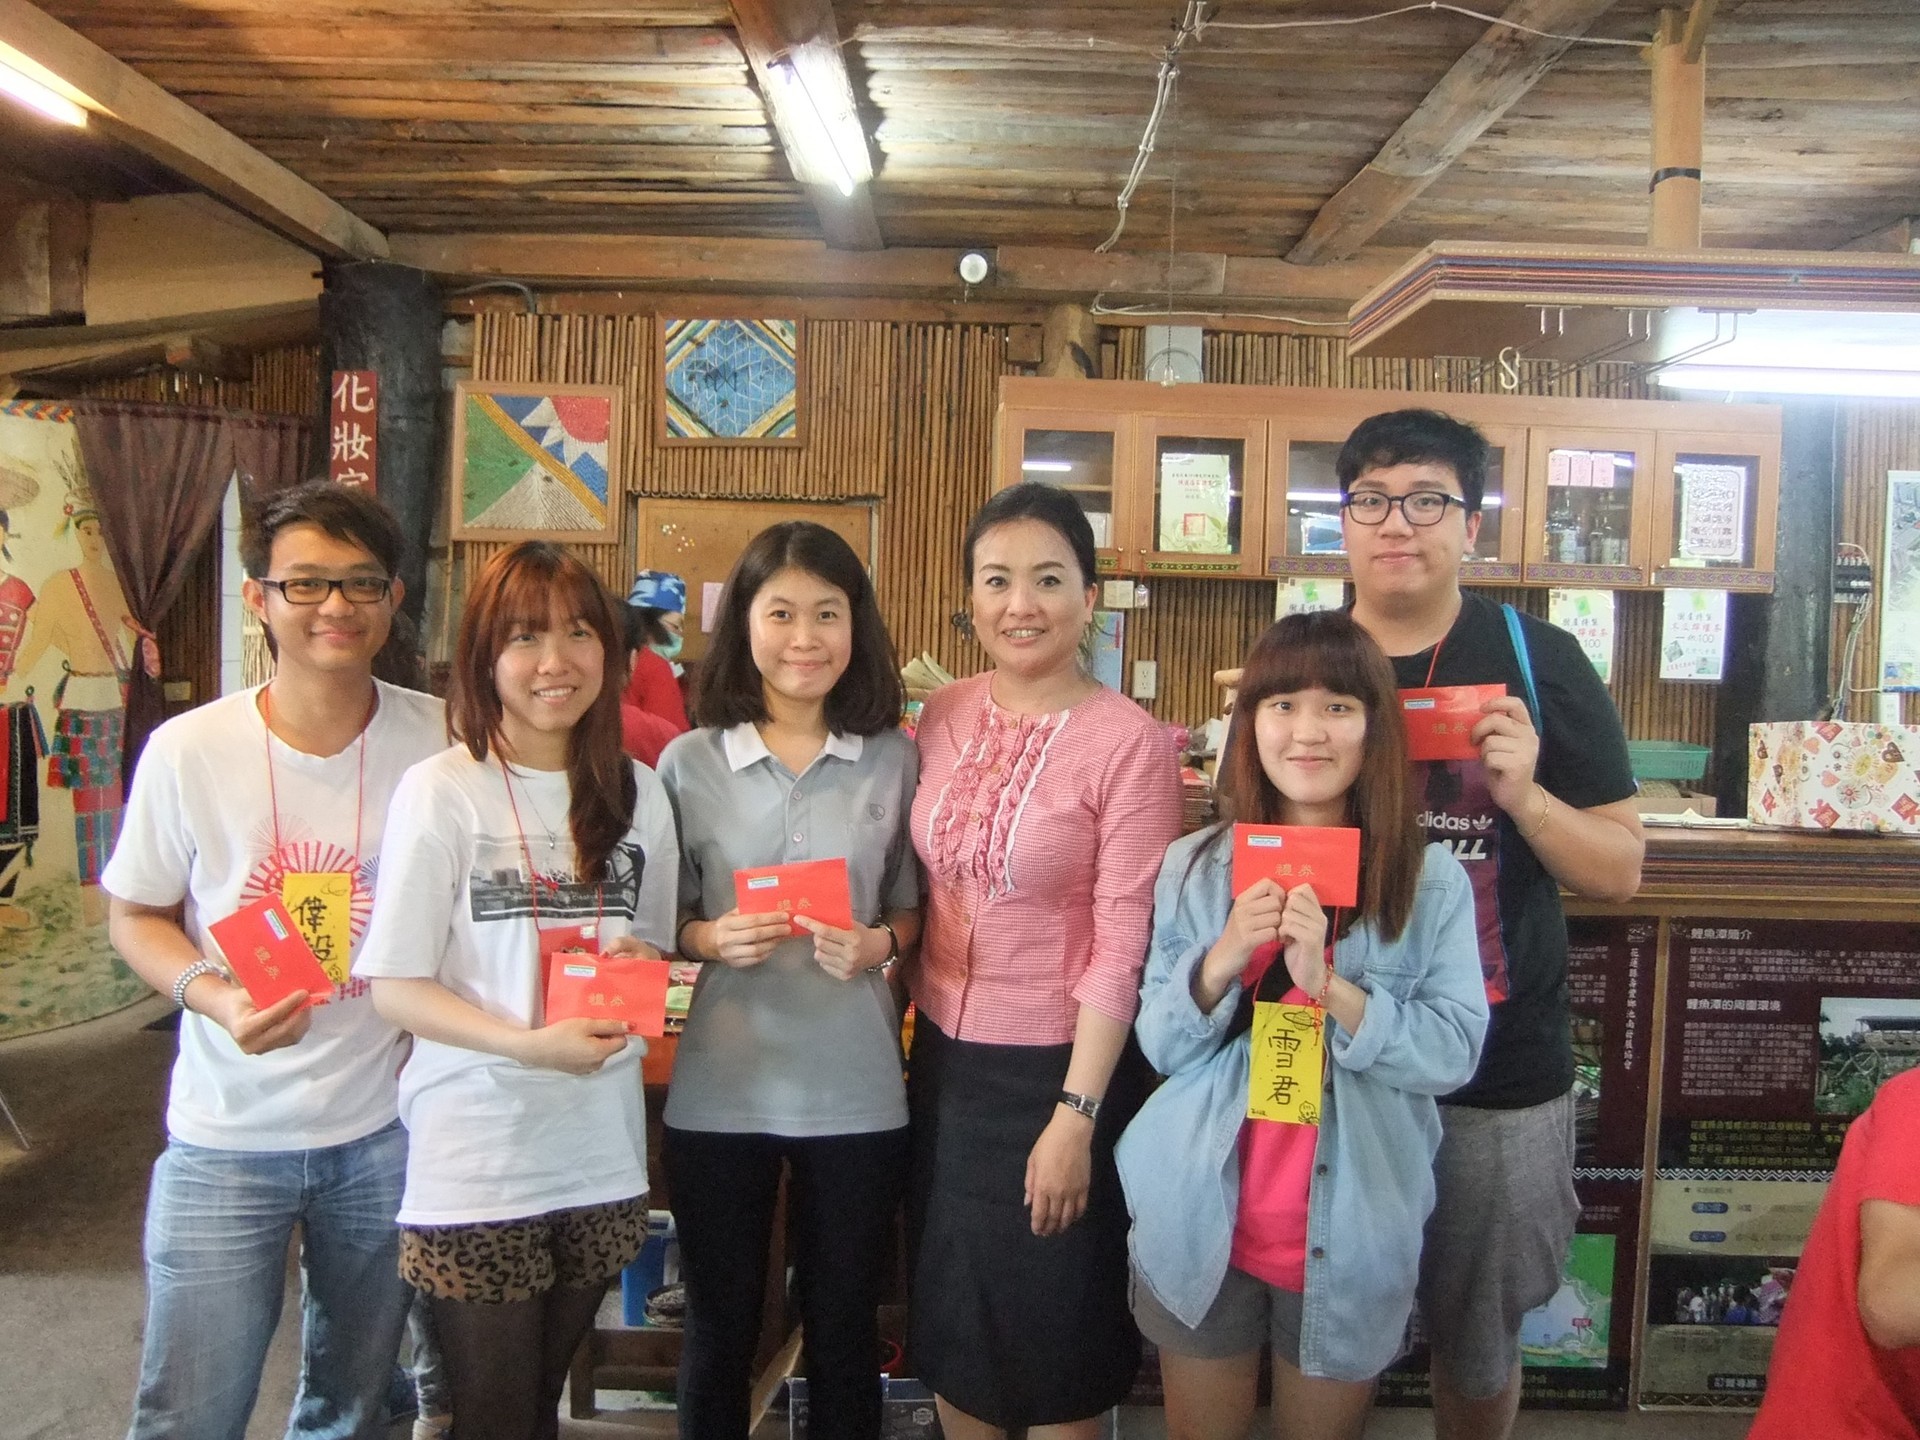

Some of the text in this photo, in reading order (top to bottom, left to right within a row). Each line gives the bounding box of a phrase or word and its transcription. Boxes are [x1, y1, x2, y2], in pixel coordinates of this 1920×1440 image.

[1416, 811, 1470, 830] didas
[1275, 863, 1315, 878] 禮券
[1266, 1028, 1302, 1106] 雪君
